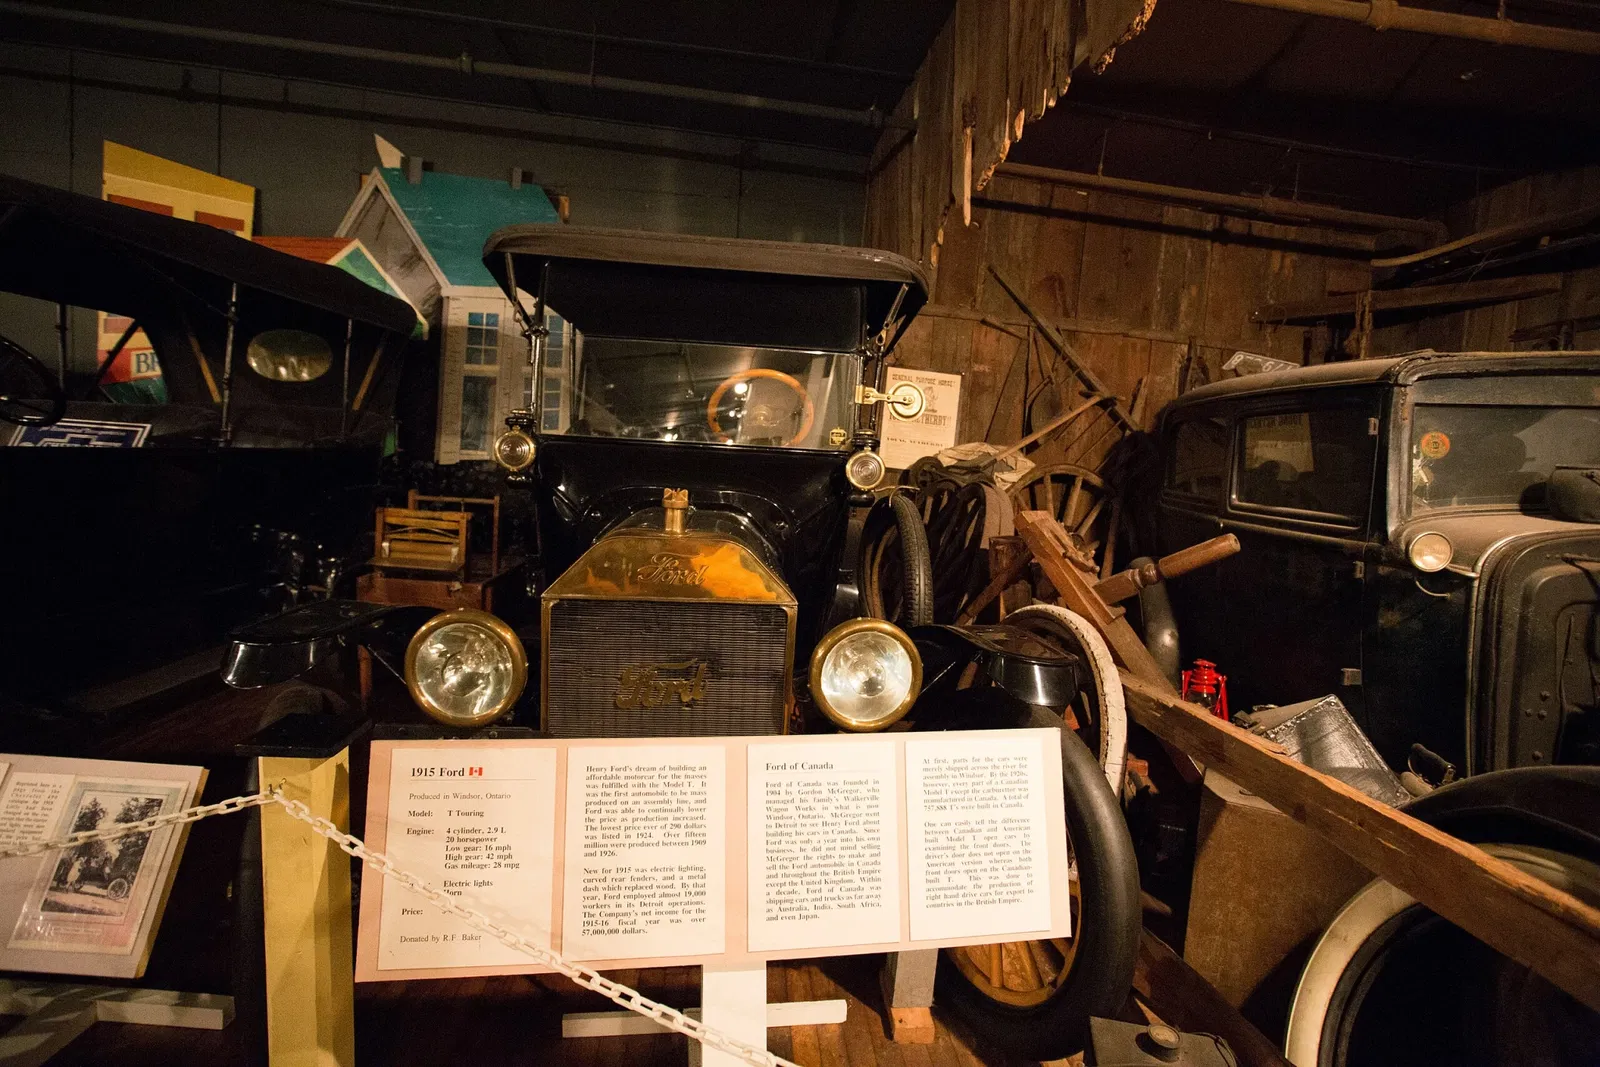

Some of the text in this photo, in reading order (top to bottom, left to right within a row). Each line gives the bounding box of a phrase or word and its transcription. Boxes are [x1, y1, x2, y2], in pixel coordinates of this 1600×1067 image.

[911, 413, 952, 426] ETHERBY!!
[636, 552, 710, 586] Ford
[616, 658, 708, 709] Ford
[412, 768, 465, 777] 1915 Ford
[456, 836, 498, 844] horsepower
[628, 841, 660, 849] produced
[497, 853, 513, 861] mph
[624, 884, 654, 892] replaced
[583, 894, 600, 902] year,
[623, 892, 657, 901] employed
[599, 910, 638, 919] Company's
[431, 935, 440, 943] by
